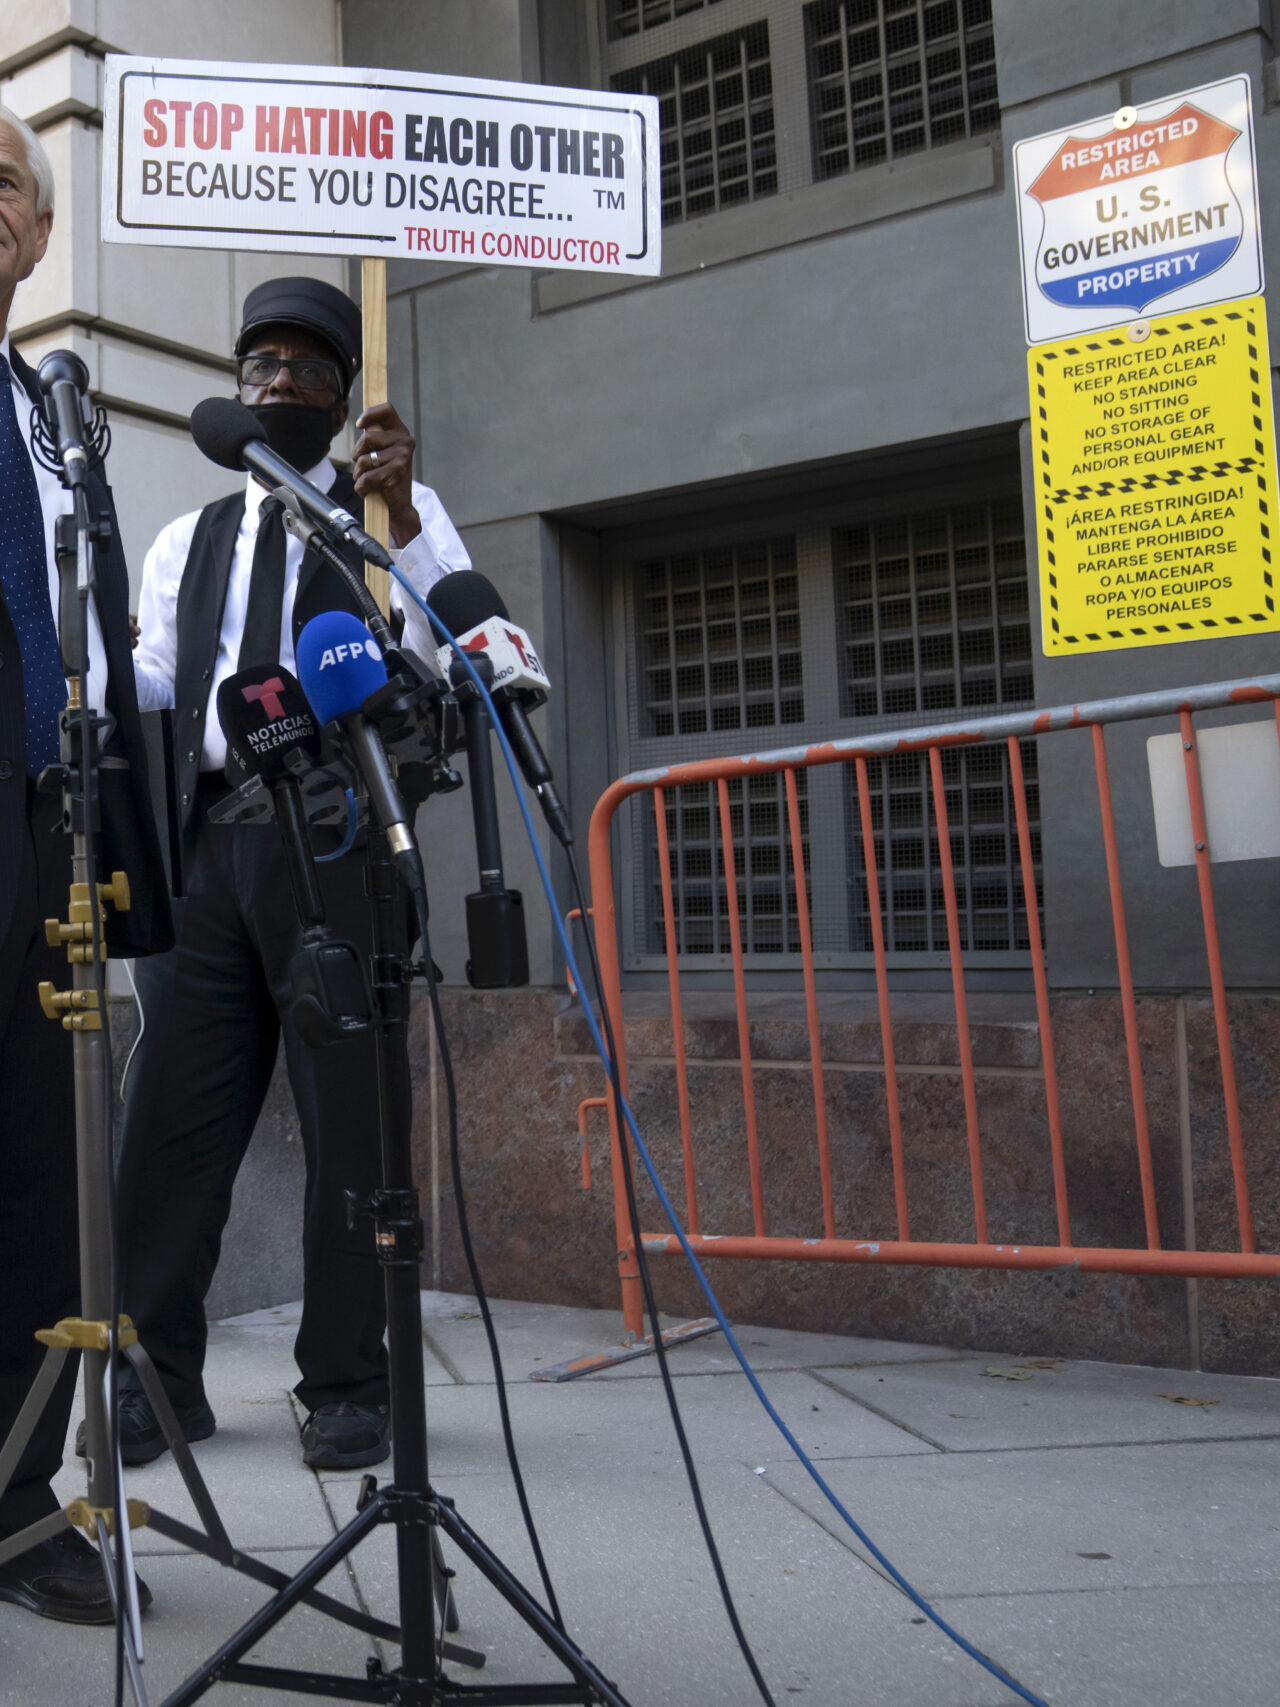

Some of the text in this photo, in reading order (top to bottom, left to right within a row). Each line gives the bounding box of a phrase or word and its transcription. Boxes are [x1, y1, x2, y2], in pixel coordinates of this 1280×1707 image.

[144, 99, 625, 179] STOP HATING EACH OTHER
[1061, 118, 1198, 171] RESTRICTED
[1100, 151, 1160, 181] AREA
[142, 160, 573, 221] BECAUSE YOU DISAGREE...
[593, 190, 625, 210] TM
[1096, 185, 1171, 223] U. S.
[404, 226, 620, 265] TRUTH CONDUCTOR
[1043, 203, 1229, 269] GOVERNMENT
[1077, 253, 1199, 298] PROPERTY
[1064, 334, 1226, 378] RESTRICTED AREA!
[1074, 355, 1216, 392] KEEP AREA CLEAR
[1094, 376, 1197, 404] NO STANDING
[1104, 394, 1188, 419] NO SITTING
[1086, 407, 1210, 439] NO STORAGE OF
[1084, 424, 1214, 456] PERSONAL GEAR
[1072, 439, 1224, 474] AND/OR EQUIPMENT
[1067, 487, 1243, 528] ¡ÁREA RESTRINGIDA!
[1077, 507, 1235, 540] MANTENGA LA ÁREA
[1088, 526, 1223, 555] LIBRE PROHIBIDO
[1078, 541, 1236, 573] PARARSE SENTARSE
[1101, 562, 1214, 586] O ALMACENAR
[1086, 577, 1232, 605] ROPA Y/O EQUIPOS
[1107, 597, 1211, 619] PERSONALES
[319, 643, 364, 671] AFP
[247, 714, 311, 745] NOTICIAS
[252, 726, 314, 754] TELEMUNDO
